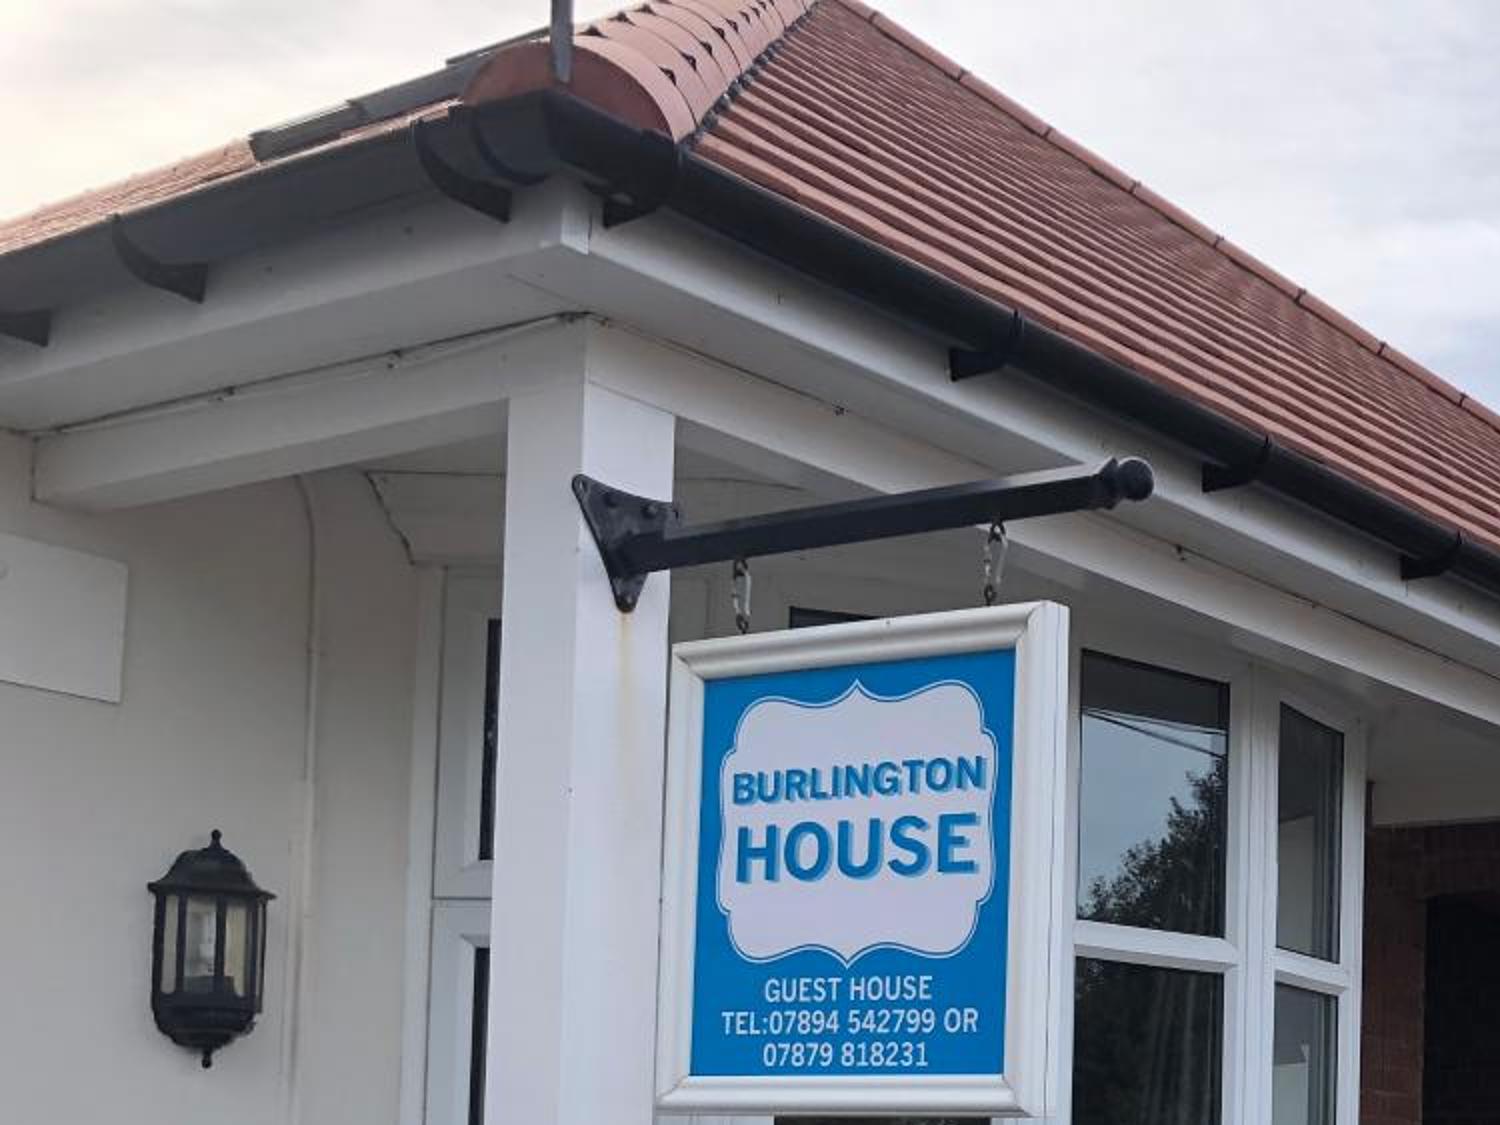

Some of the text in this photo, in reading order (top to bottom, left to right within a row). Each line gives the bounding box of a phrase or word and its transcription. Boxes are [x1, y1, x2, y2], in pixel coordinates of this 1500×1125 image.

[732, 756, 988, 806] BURLINGTON
[734, 812, 982, 884] HOUSE
[764, 975, 933, 1003] GUEST HOUSE
[721, 1008, 978, 1036] TEL:07894 542799 OR
[763, 1042, 929, 1067] 07879 818231
